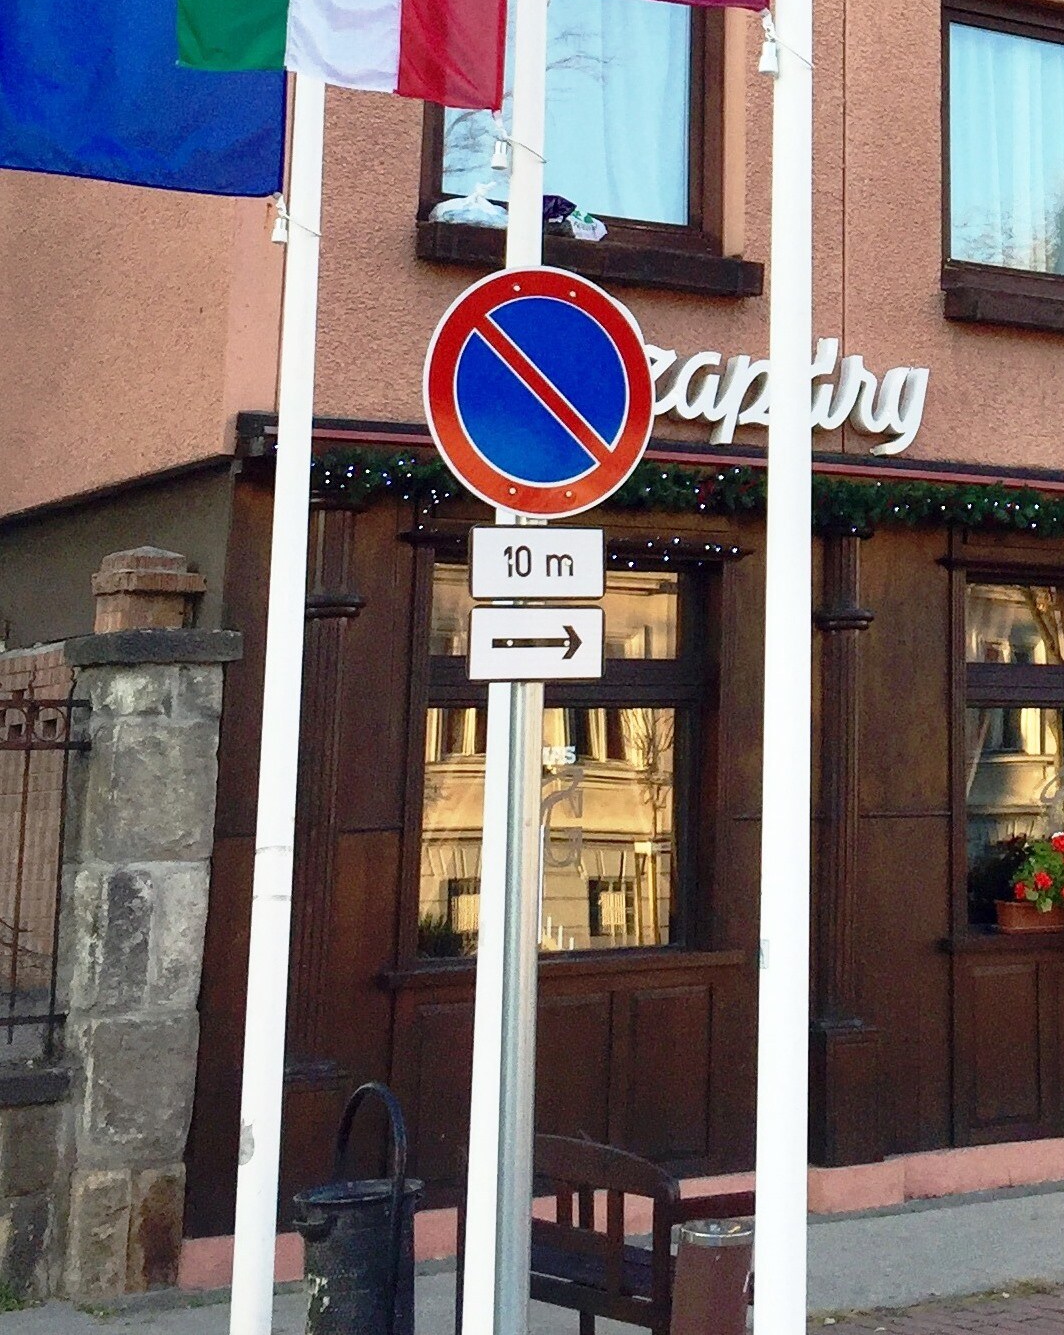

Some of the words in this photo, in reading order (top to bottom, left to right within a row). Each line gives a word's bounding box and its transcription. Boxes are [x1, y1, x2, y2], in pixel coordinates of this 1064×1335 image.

[625, 316, 930, 456] zapry
[503, 544, 532, 578] 10
[545, 552, 574, 578] m
